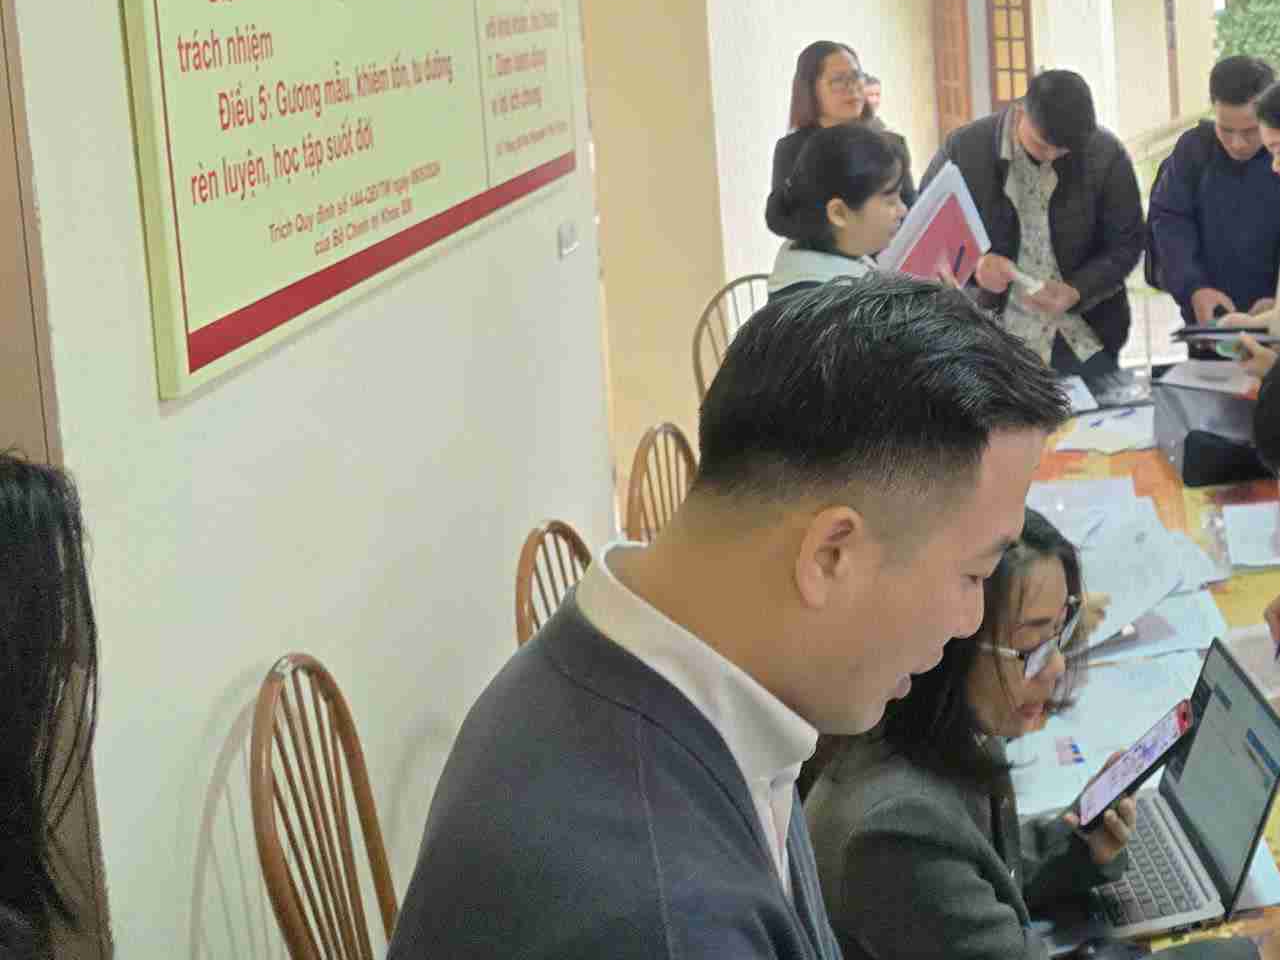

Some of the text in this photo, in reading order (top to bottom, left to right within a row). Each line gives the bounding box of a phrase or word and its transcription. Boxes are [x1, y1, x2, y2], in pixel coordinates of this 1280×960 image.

[177, 24, 273, 73] trách nhiệm
[276, 79, 322, 119] Gương
[191, 161, 219, 206] rèn
[222, 150, 271, 201] luyện,
[272, 143, 300, 184] học
[302, 133, 325, 178] tập
